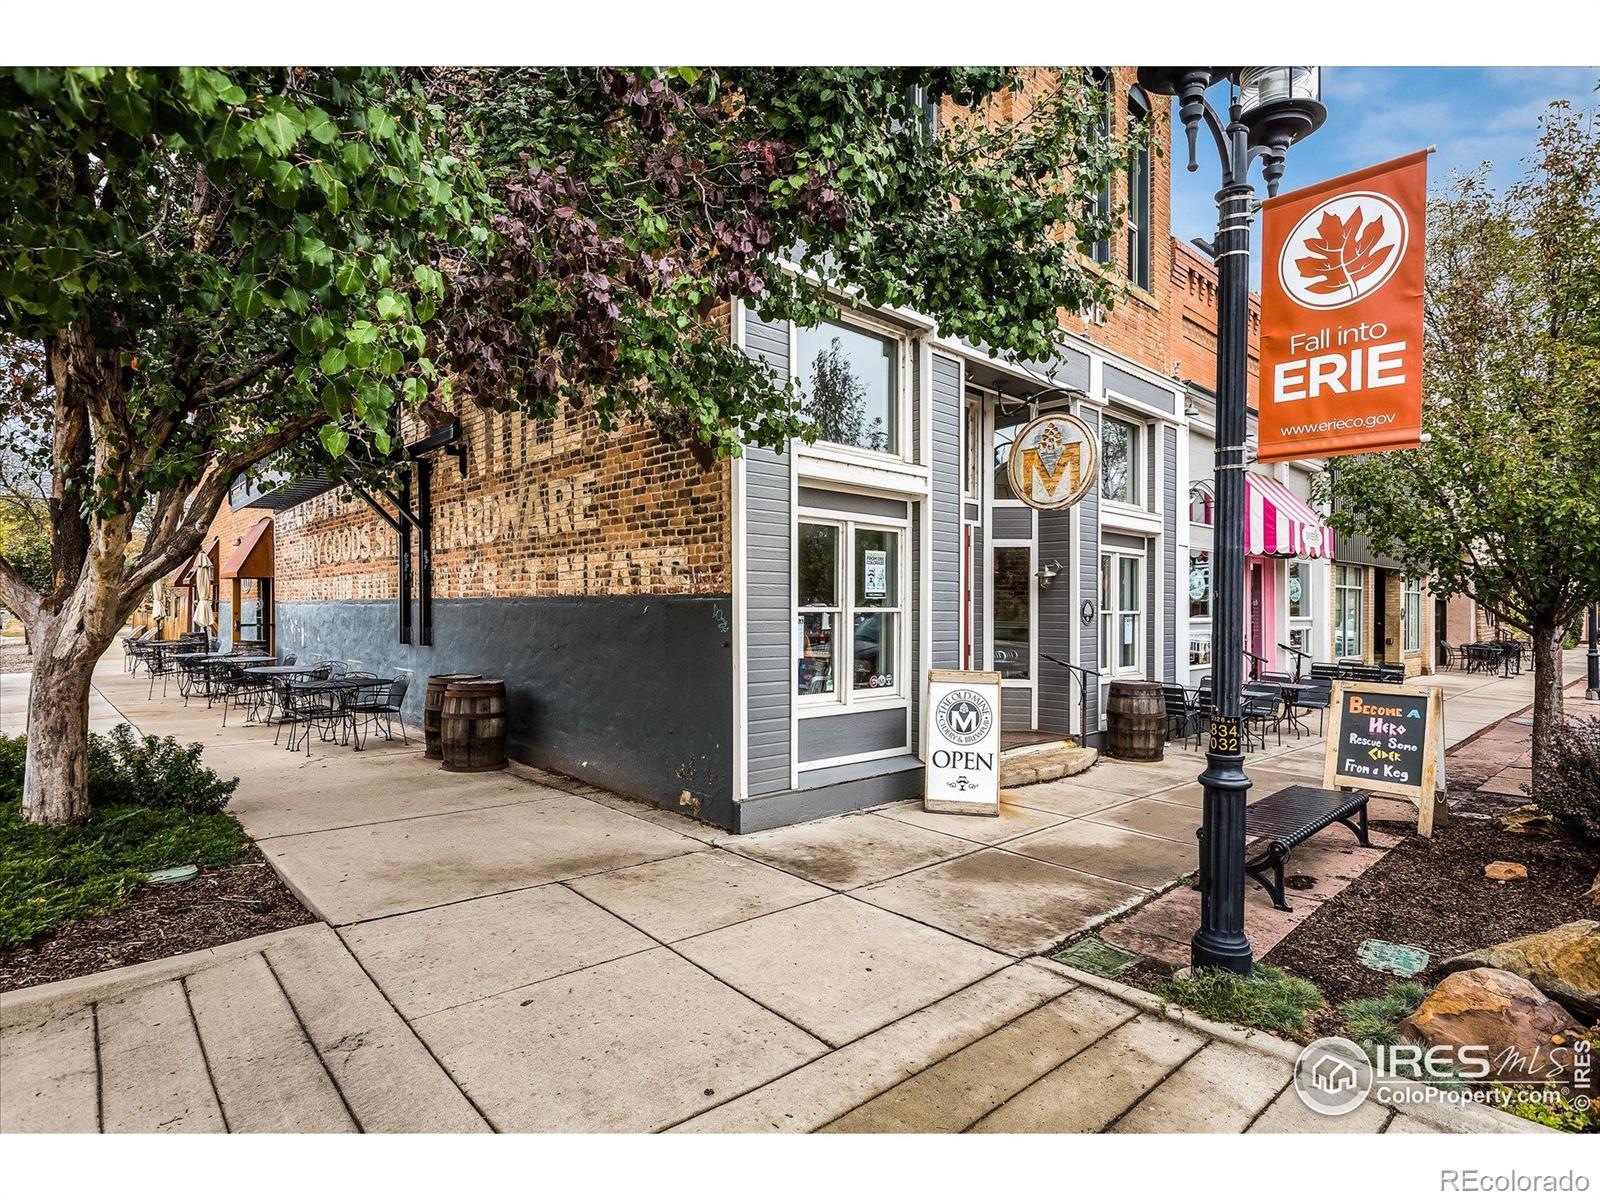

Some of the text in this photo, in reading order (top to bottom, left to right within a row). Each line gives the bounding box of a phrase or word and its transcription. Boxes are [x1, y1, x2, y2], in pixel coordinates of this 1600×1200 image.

[1289, 321, 1388, 355] Fall into
[1273, 340, 1407, 404] ERIE
[1280, 412, 1397, 438] www.erieco.gov
[430, 471, 602, 550] HARDWARE
[938, 691, 991, 716] THE OLD MINE
[1406, 709, 1421, 719] A
[938, 718, 958, 742] CIDERY
[964, 719, 990, 743] BREWPUB
[1349, 733, 1418, 752] Rescue Some
[932, 750, 994, 771] OPEN
[1367, 747, 1402, 762] CIDER
[1344, 758, 1409, 782] From a Keg
